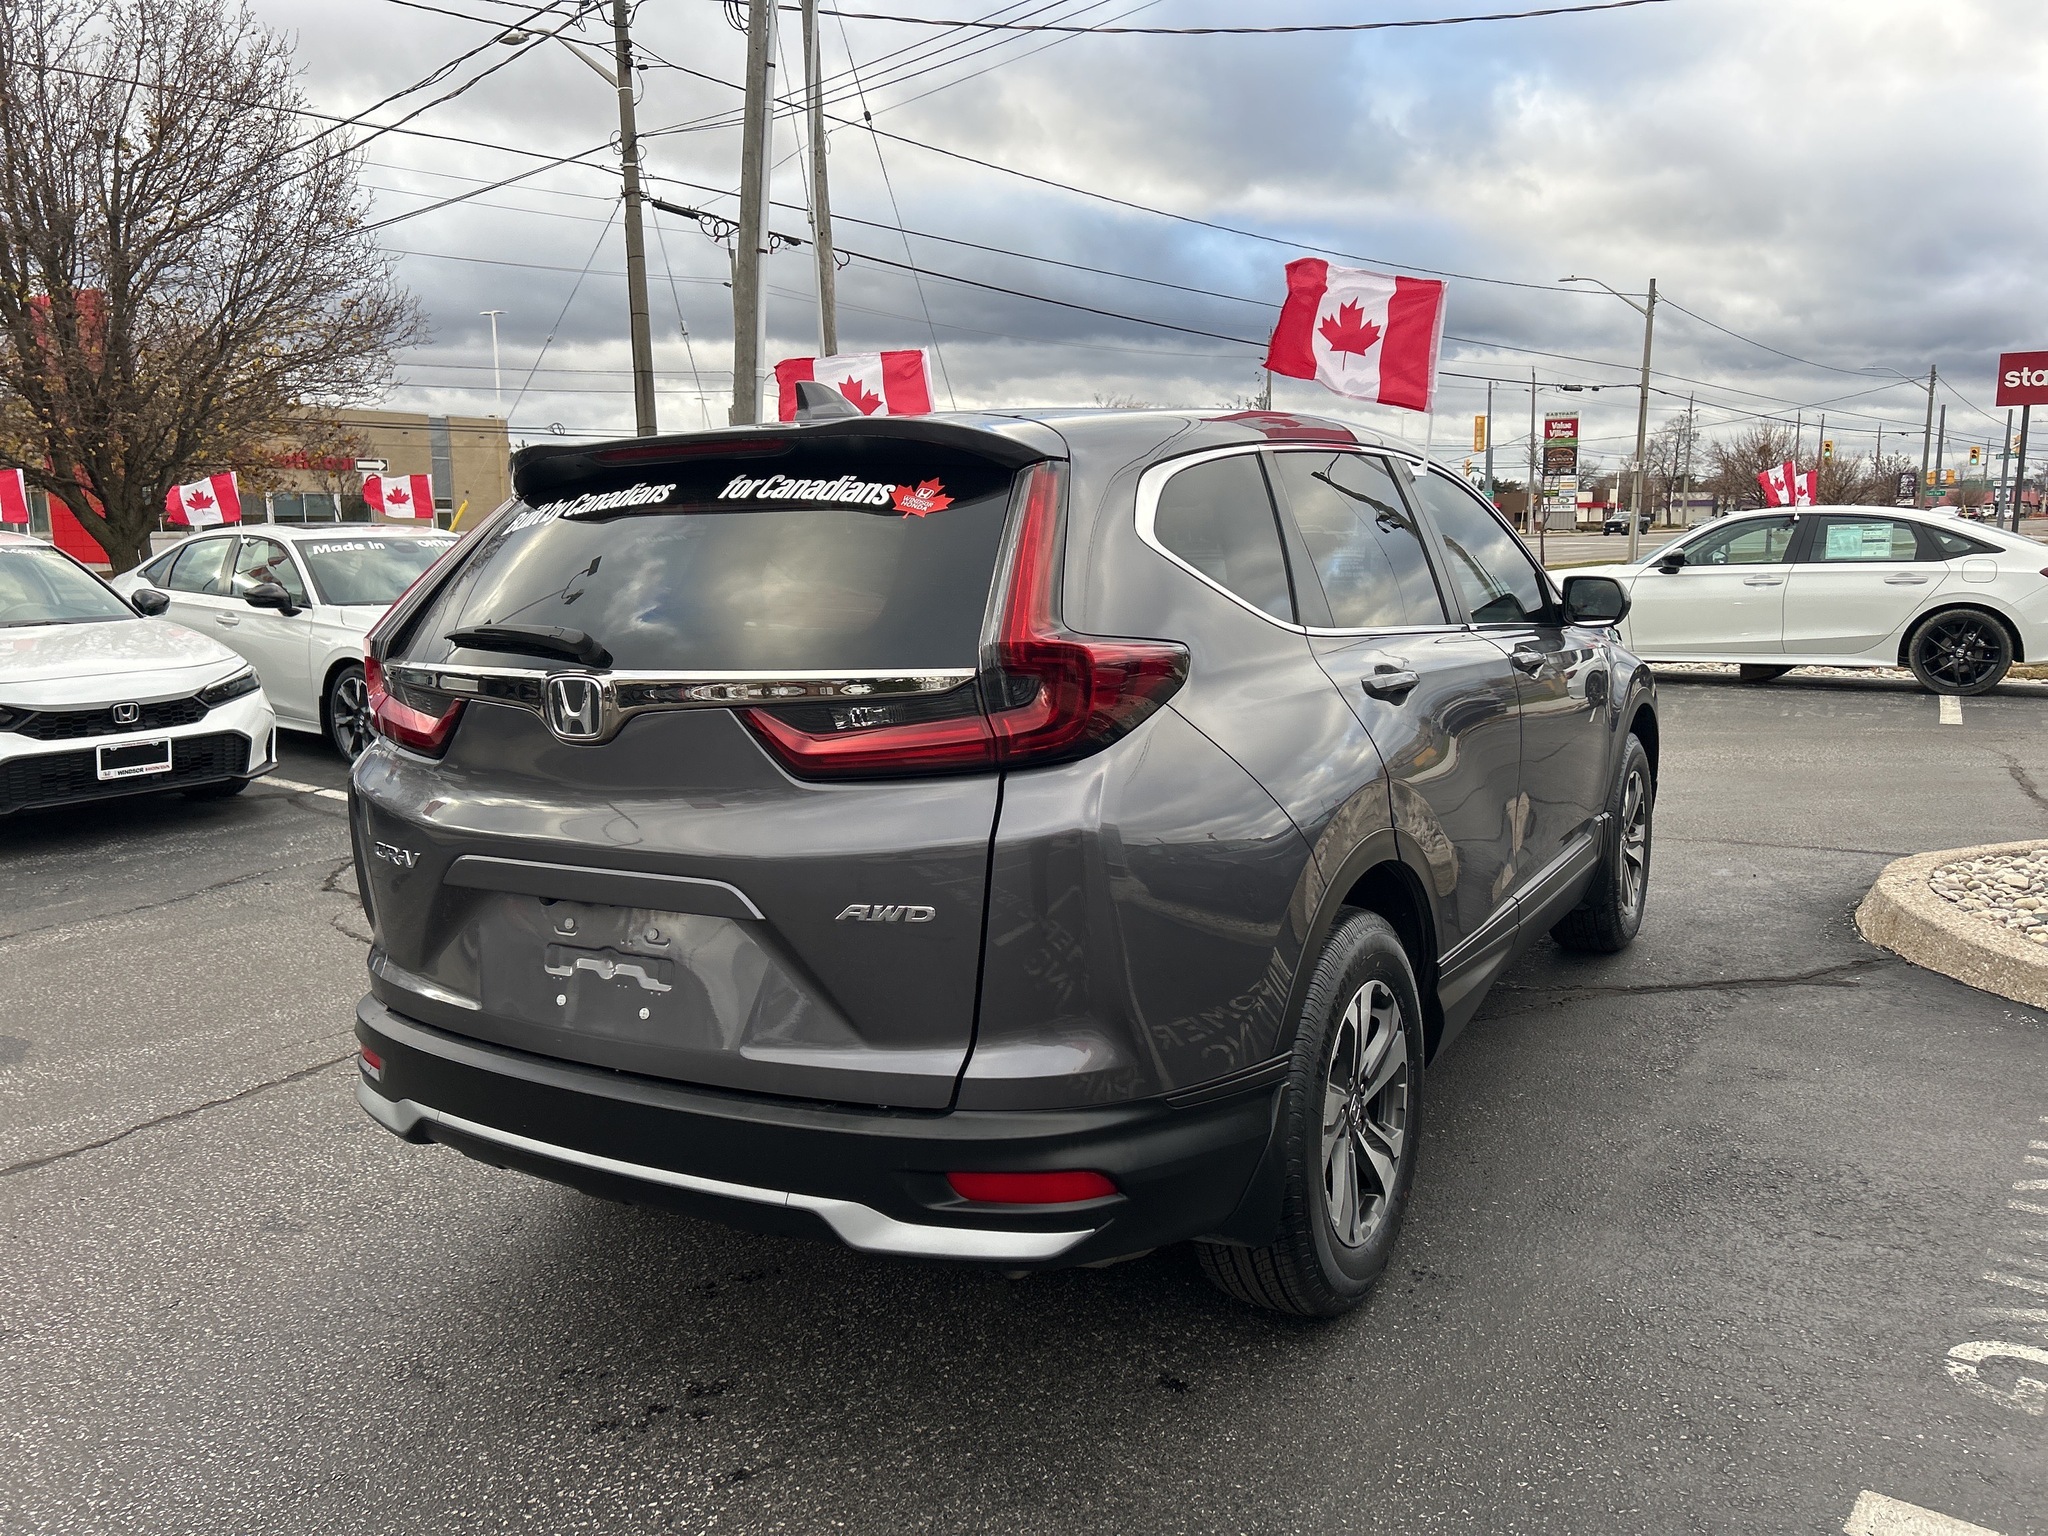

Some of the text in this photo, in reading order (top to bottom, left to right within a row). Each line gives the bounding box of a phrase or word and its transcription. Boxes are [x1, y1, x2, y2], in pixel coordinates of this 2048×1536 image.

[1551, 421, 1572, 429] Value
[1549, 429, 1574, 438] Village
[718, 474, 896, 506] for Canadians
[564, 482, 677, 517] Canadians
[900, 500, 928, 512] HONDA
[903, 495, 934, 508] WINDSOR
[313, 541, 363, 555] Made
[834, 904, 937, 923] AWD
